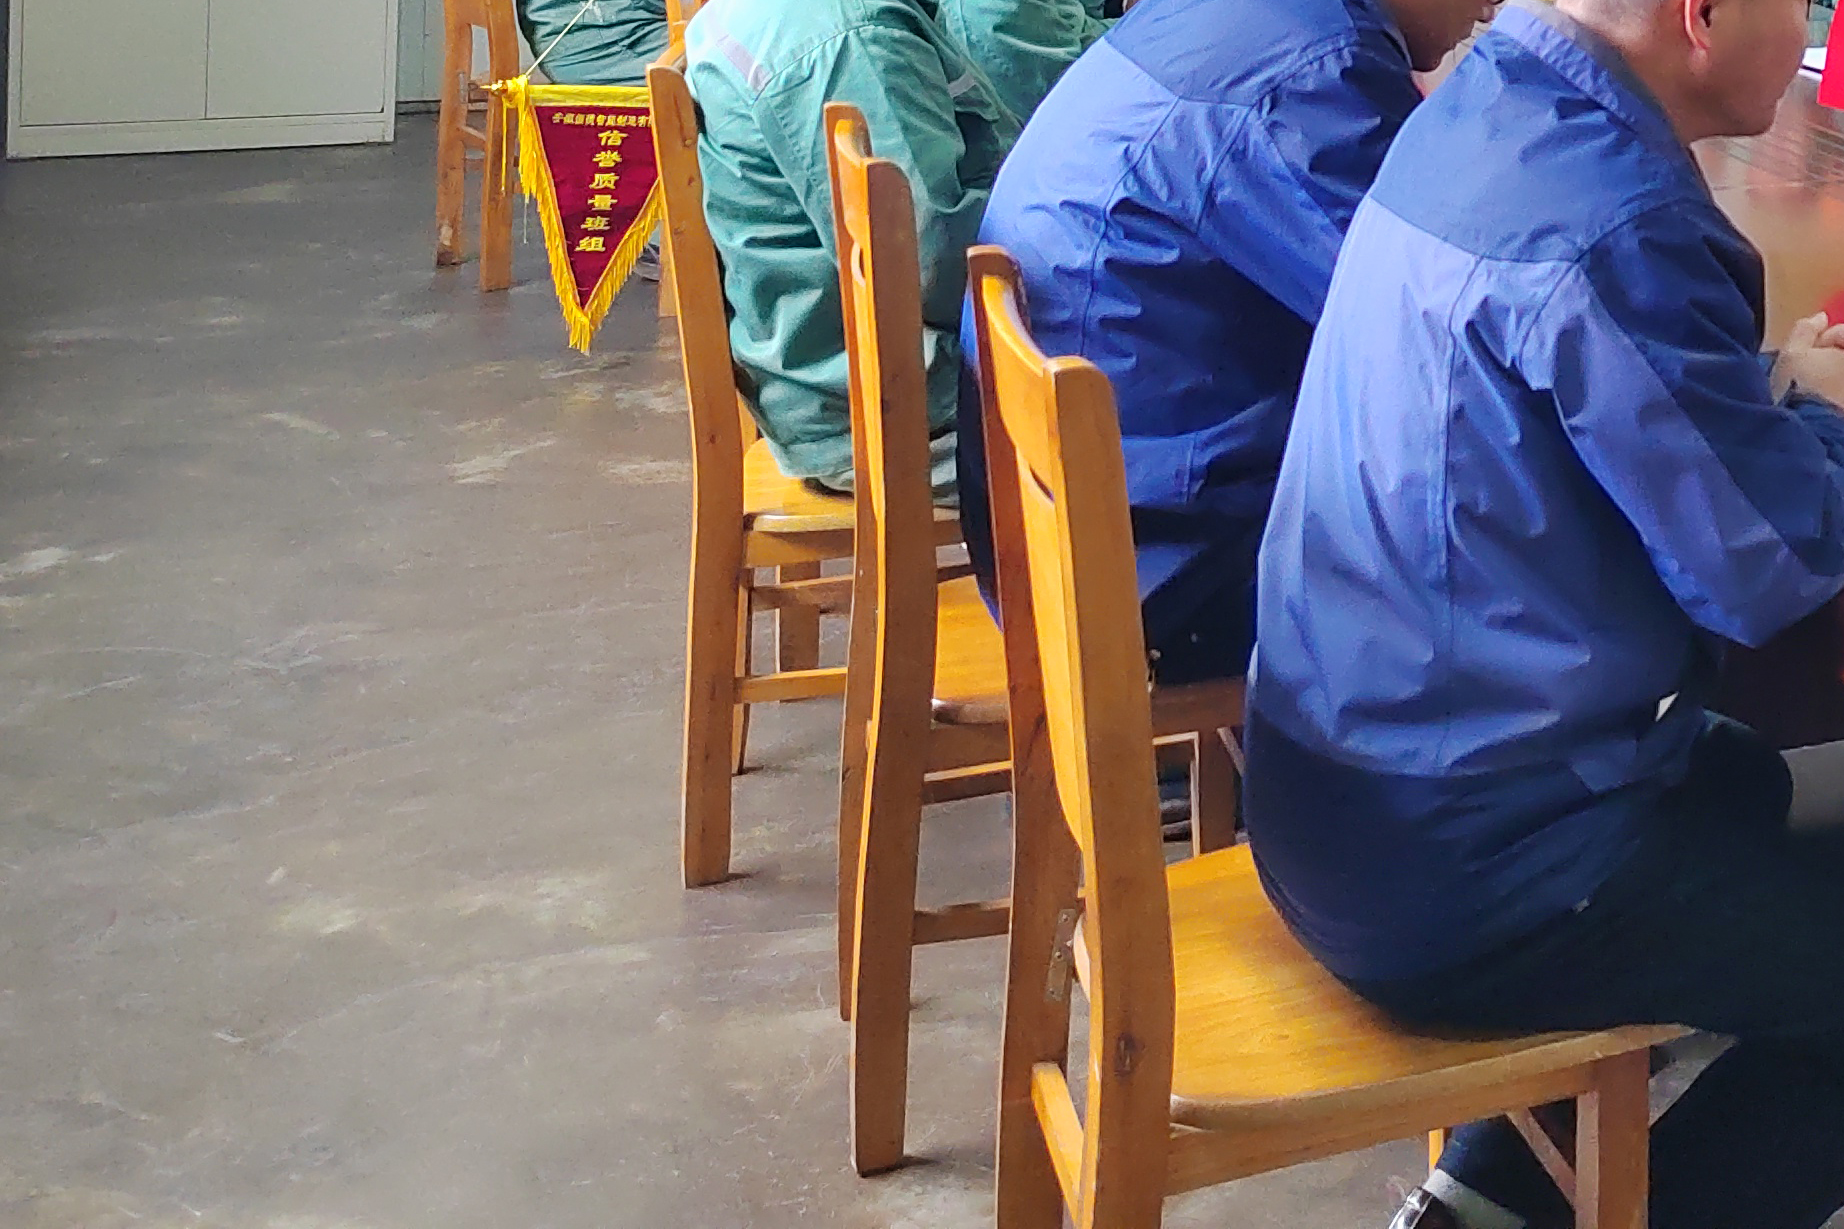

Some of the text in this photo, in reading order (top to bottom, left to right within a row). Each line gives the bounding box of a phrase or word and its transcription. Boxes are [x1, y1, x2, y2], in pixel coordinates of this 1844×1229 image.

[574, 130, 628, 252] 信誉质量班组
